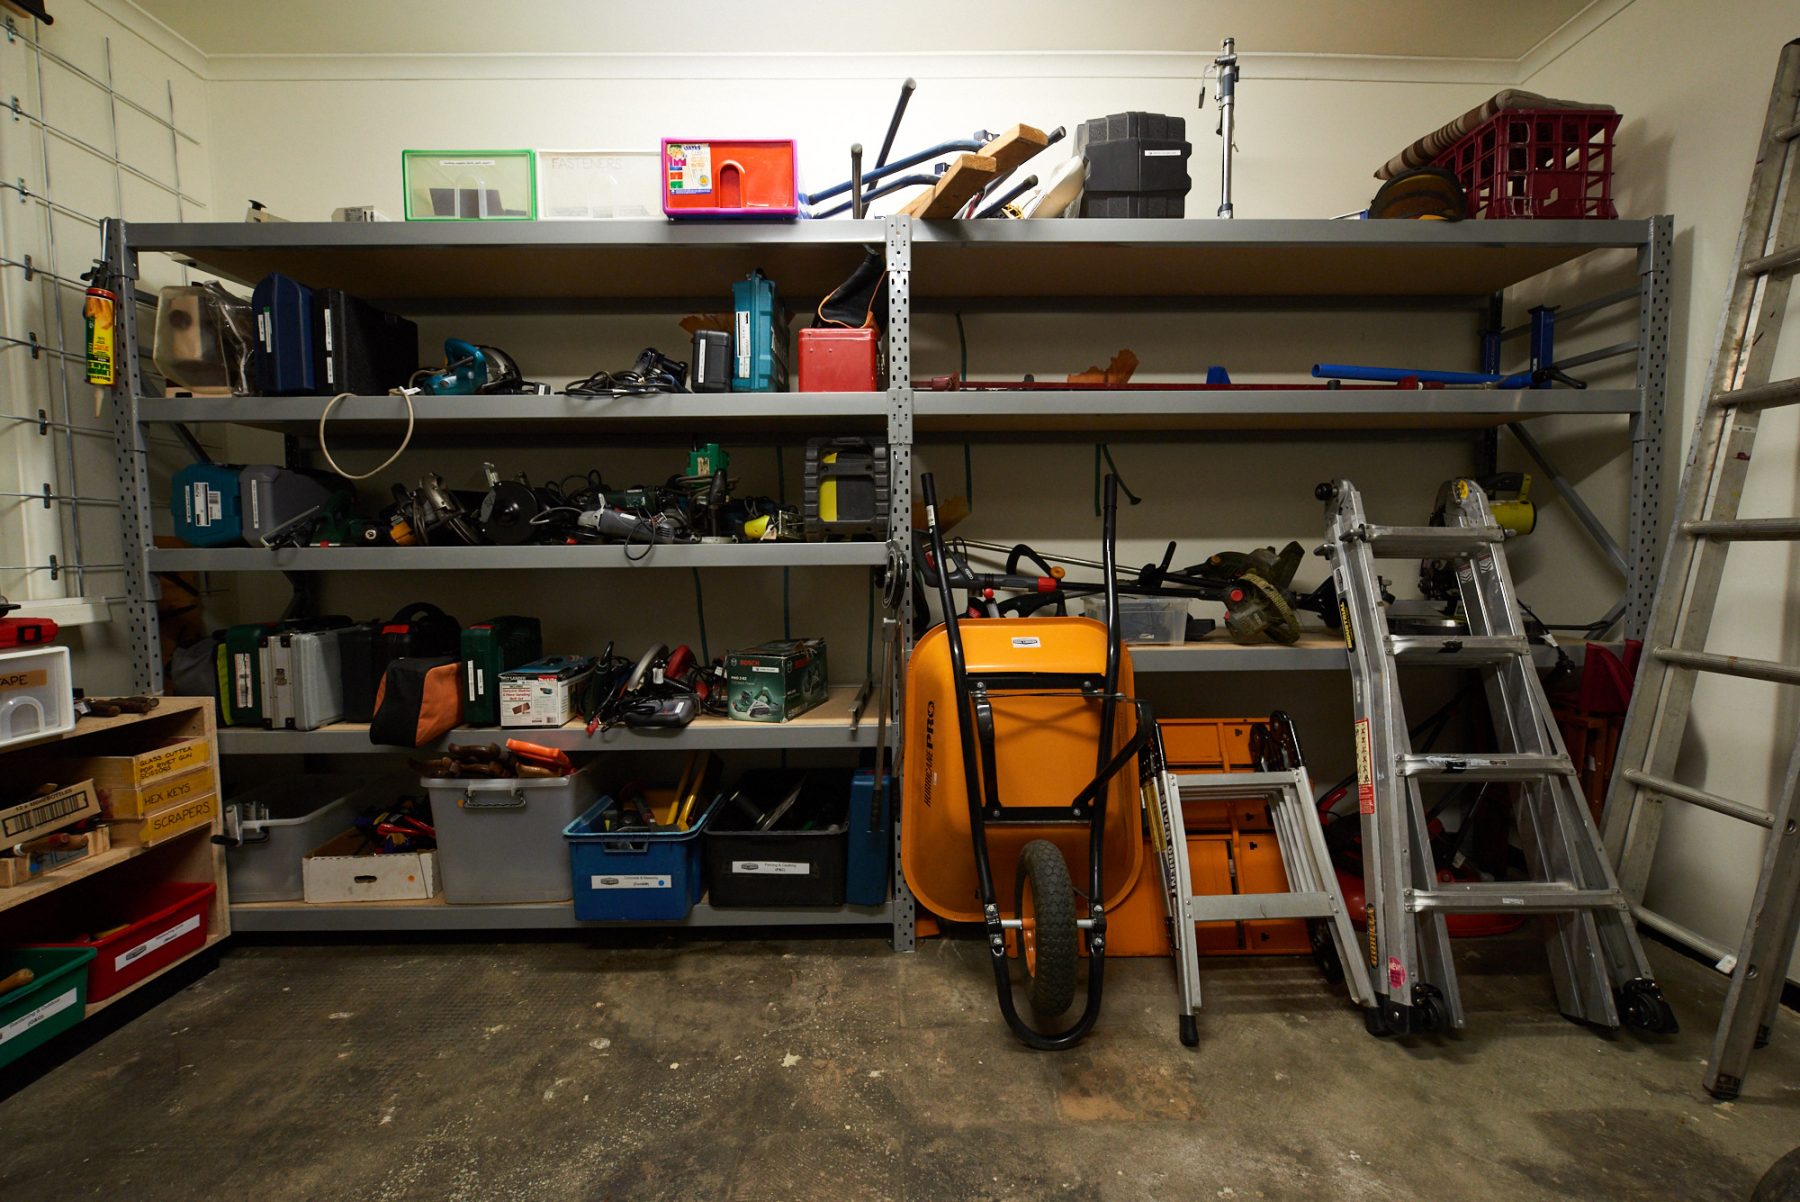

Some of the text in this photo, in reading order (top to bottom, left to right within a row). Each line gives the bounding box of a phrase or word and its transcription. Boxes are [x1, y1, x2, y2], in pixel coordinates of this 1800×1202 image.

[552, 157, 622, 170] FASTENERS
[1341, 601, 1352, 649] INDUSTRIAL
[0, 674, 28, 687] APE
[139, 746, 193, 767] GLASS CUTTER
[140, 752, 193, 774] POP RIVET GUN
[140, 764, 172, 780] SCISSORS
[924, 750, 933, 808] HURRICANE
[144, 783, 191, 806] HEX KEYS
[154, 801, 211, 830] SCRAPERS
